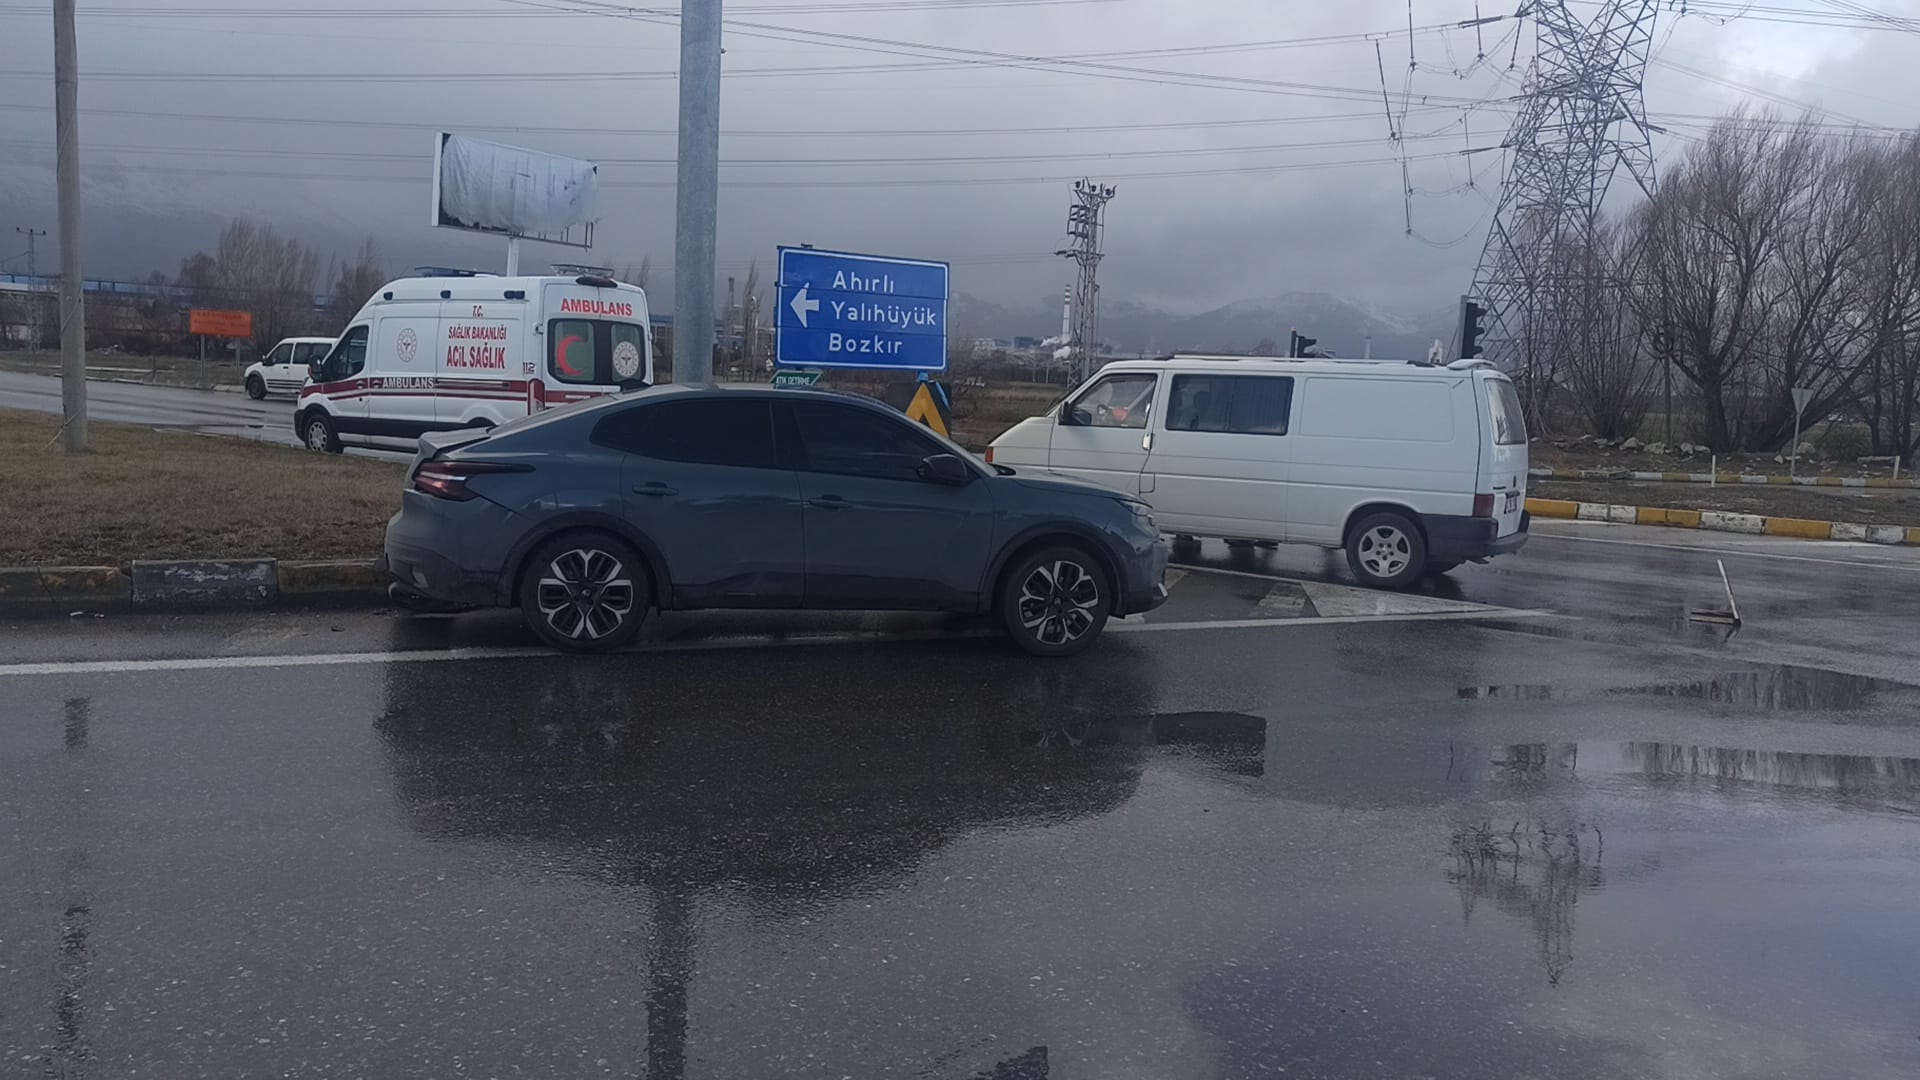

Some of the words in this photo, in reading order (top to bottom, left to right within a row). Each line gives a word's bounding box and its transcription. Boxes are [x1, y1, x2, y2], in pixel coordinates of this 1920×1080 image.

[832, 270, 894, 293] Ahırlı
[561, 298, 632, 316] AMBULANS
[831, 300, 936, 329] Yalıhüyük
[448, 323, 471, 339] SAĞLIK
[471, 324, 507, 340] BAKANLIĞI
[829, 332, 903, 354] Bozkır
[469, 342, 506, 369] SAĞLIK
[522, 362, 536, 374] 112
[382, 377, 434, 390] AMBULANS
